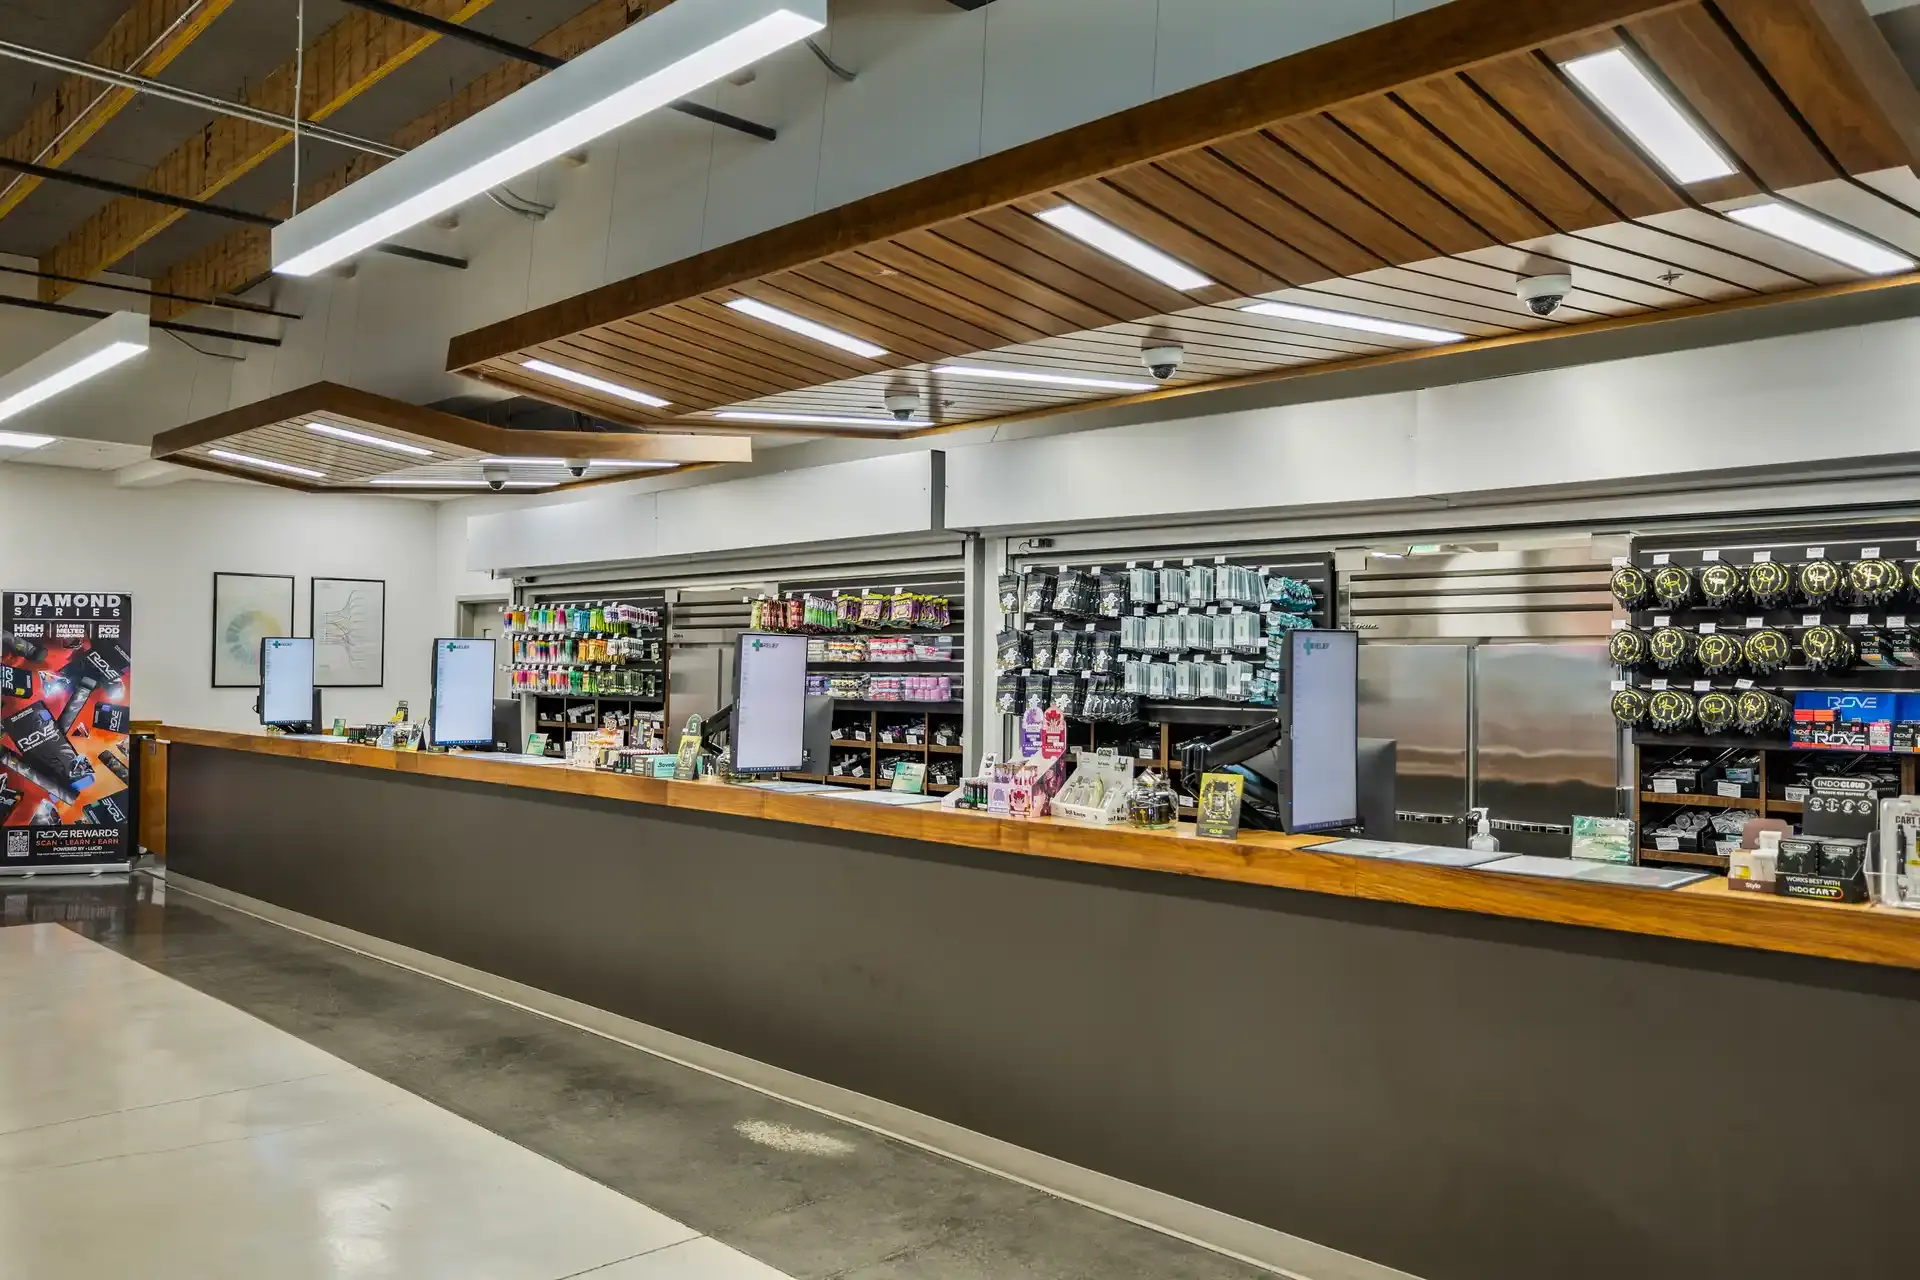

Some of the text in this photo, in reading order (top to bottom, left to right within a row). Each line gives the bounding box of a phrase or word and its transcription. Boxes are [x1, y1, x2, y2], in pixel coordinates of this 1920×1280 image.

[14, 593, 121, 607] DIAMOND
[14, 607, 120, 616] SERIES
[14, 624, 44, 633] HIGH
[89, 651, 121, 680] ROVE
[1828, 696, 1877, 709] ROVE
[109, 710, 120, 731] ROVE
[18, 719, 56, 749] ROVE
[1814, 733, 1866, 746] ROVE
[1817, 780, 1866, 789] INDOCLOUD
[1895, 816, 1916, 825] CART
[36, 828, 119, 838] ROVE REWARDS
[1786, 875, 1809, 883] WORKS
[1823, 879, 1841, 887] WITH
[1788, 885, 1838, 896] INDOCART
